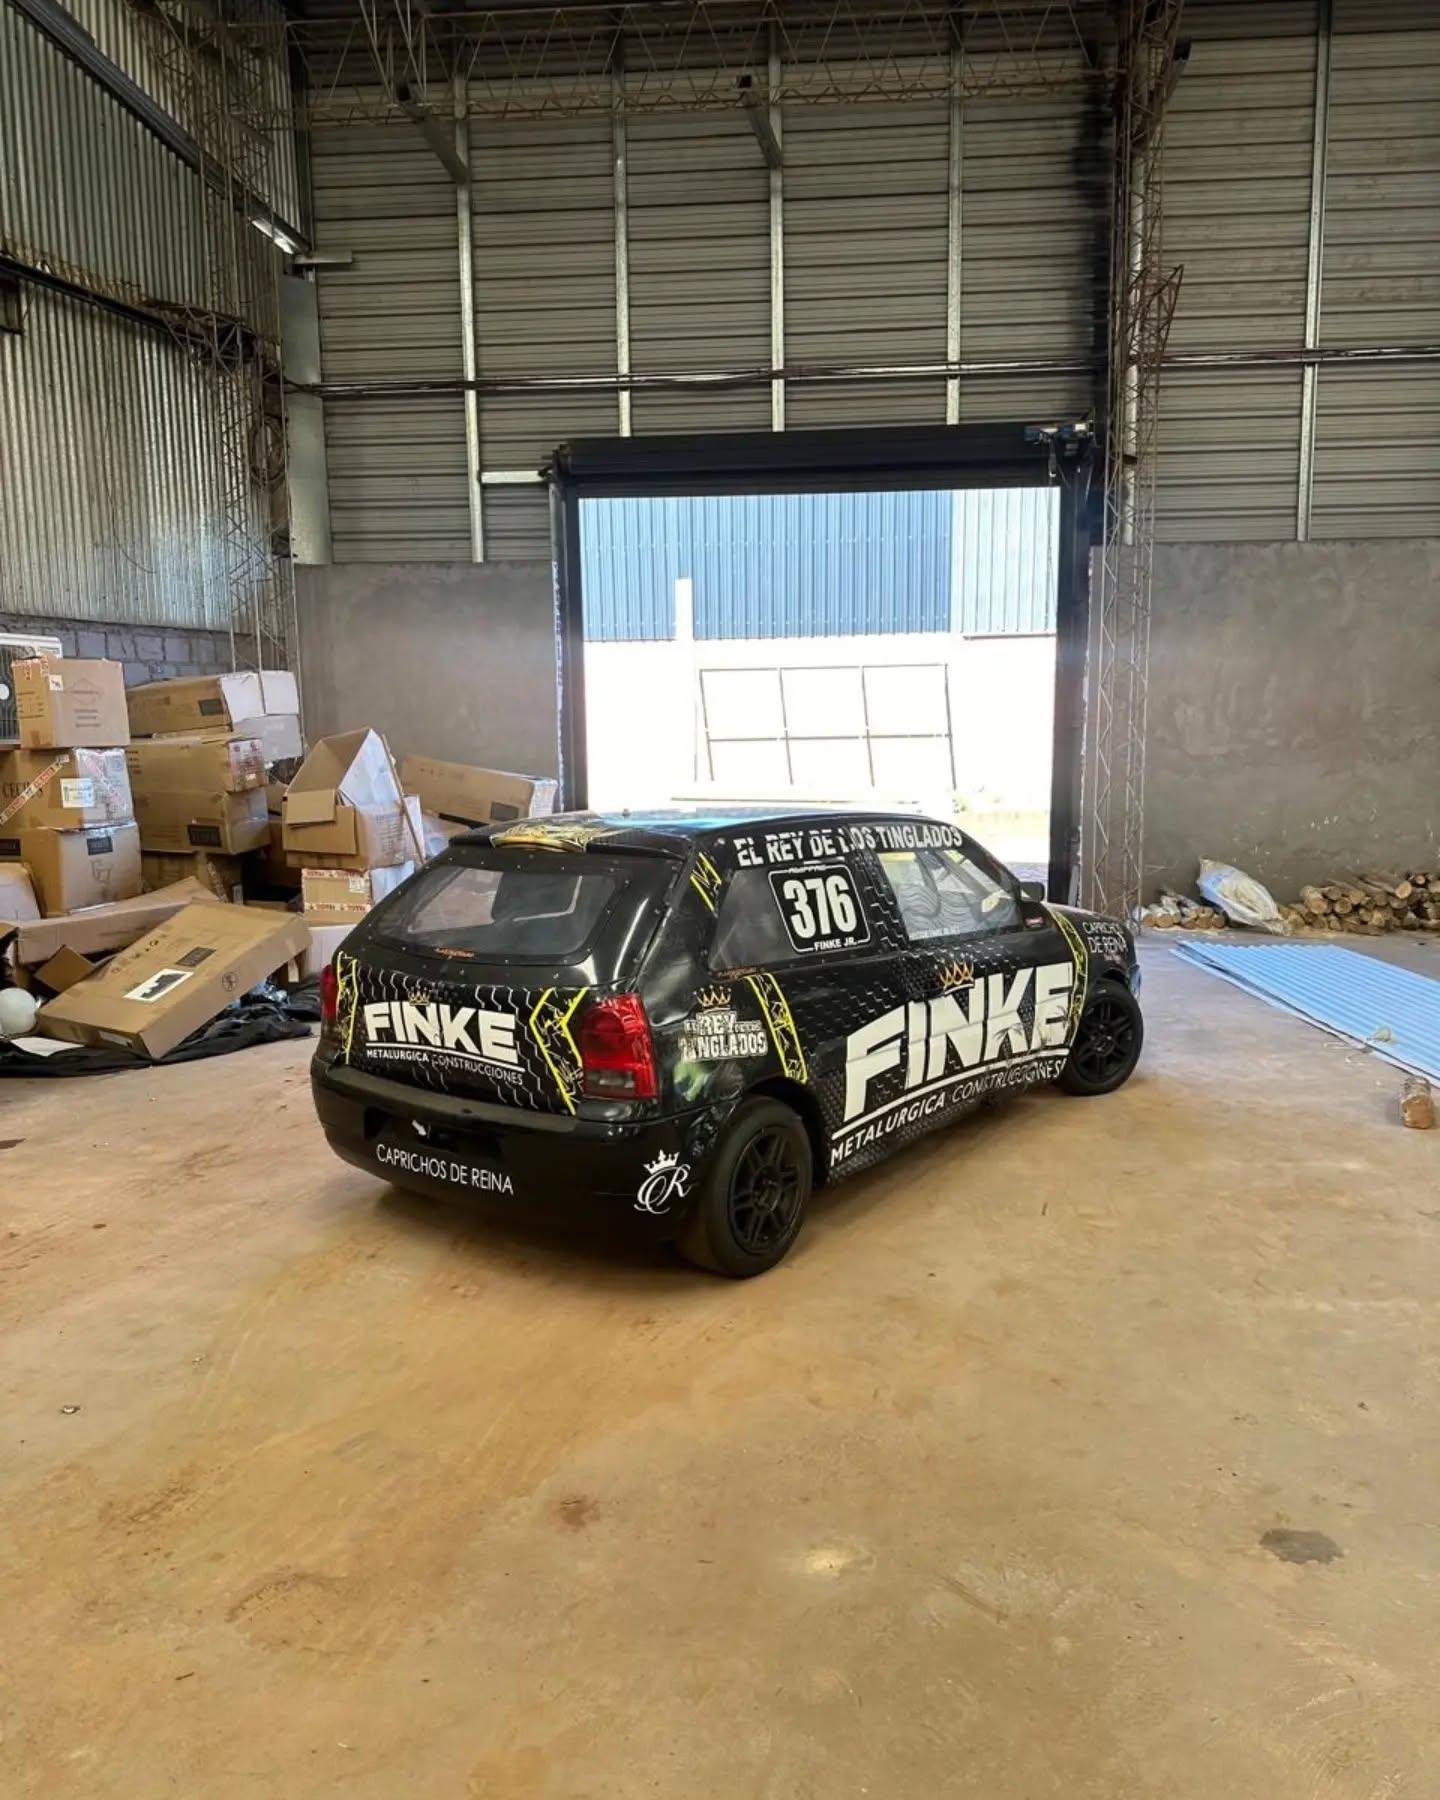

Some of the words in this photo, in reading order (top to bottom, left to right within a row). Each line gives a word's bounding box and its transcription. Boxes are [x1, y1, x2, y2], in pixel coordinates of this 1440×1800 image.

[733, 836, 764, 867] EL
[765, 831, 804, 863] REY
[809, 829, 837, 858] DE
[838, 826, 877, 853] LOS
[877, 825, 963, 850] TINGLADOS
[783, 875, 857, 939] 376
[814, 939, 842, 951] FINKE
[1088, 936, 1102, 953] DE
[364, 1001, 519, 1064] FINKE
[698, 1011, 737, 1036] REY
[843, 961, 1074, 1122] FINKE
[367, 1049, 430, 1063] METALURGICA
[431, 1054, 524, 1086] CONSTRUCCIONES
[830, 1090, 946, 1167] METALURGICA
[376, 1144, 447, 1180] CAPRICHOS
[450, 1163, 468, 1185] DE
[471, 1168, 514, 1195] REINA
